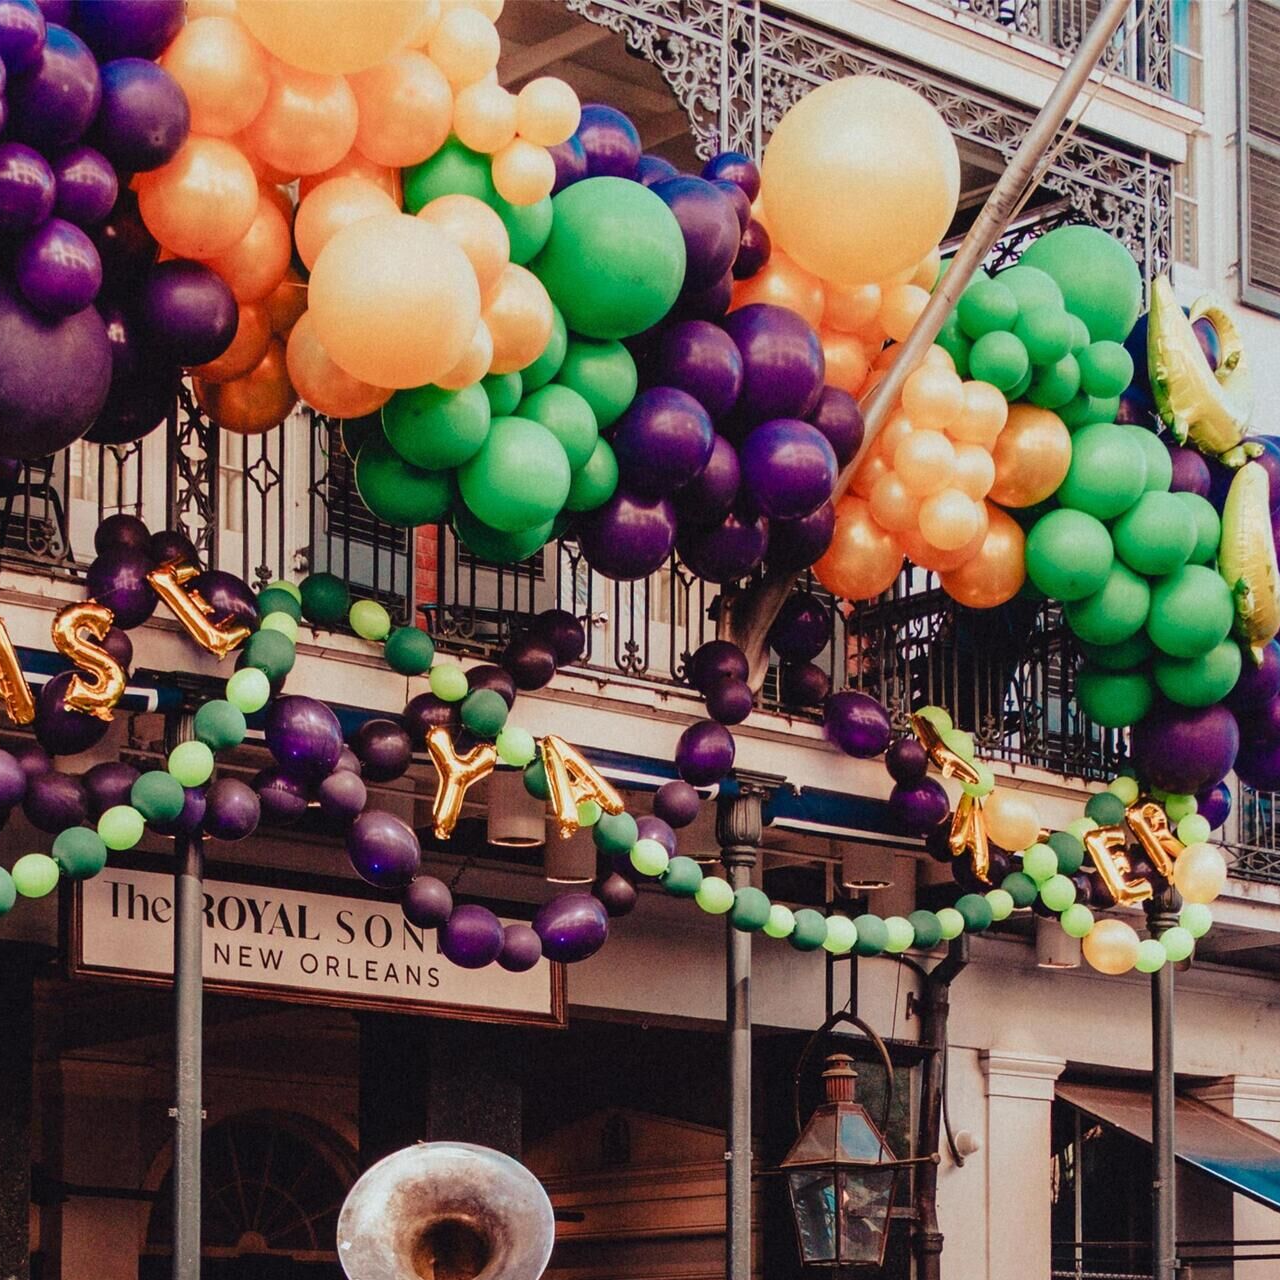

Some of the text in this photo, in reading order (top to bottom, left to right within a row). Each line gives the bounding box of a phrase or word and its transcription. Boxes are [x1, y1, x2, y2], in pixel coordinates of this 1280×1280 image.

[426, 725, 625, 840] YA
[104, 880, 172, 923] The
[336, 909, 442, 955] SON
[214, 942, 441, 988] NEW ORLEANS
